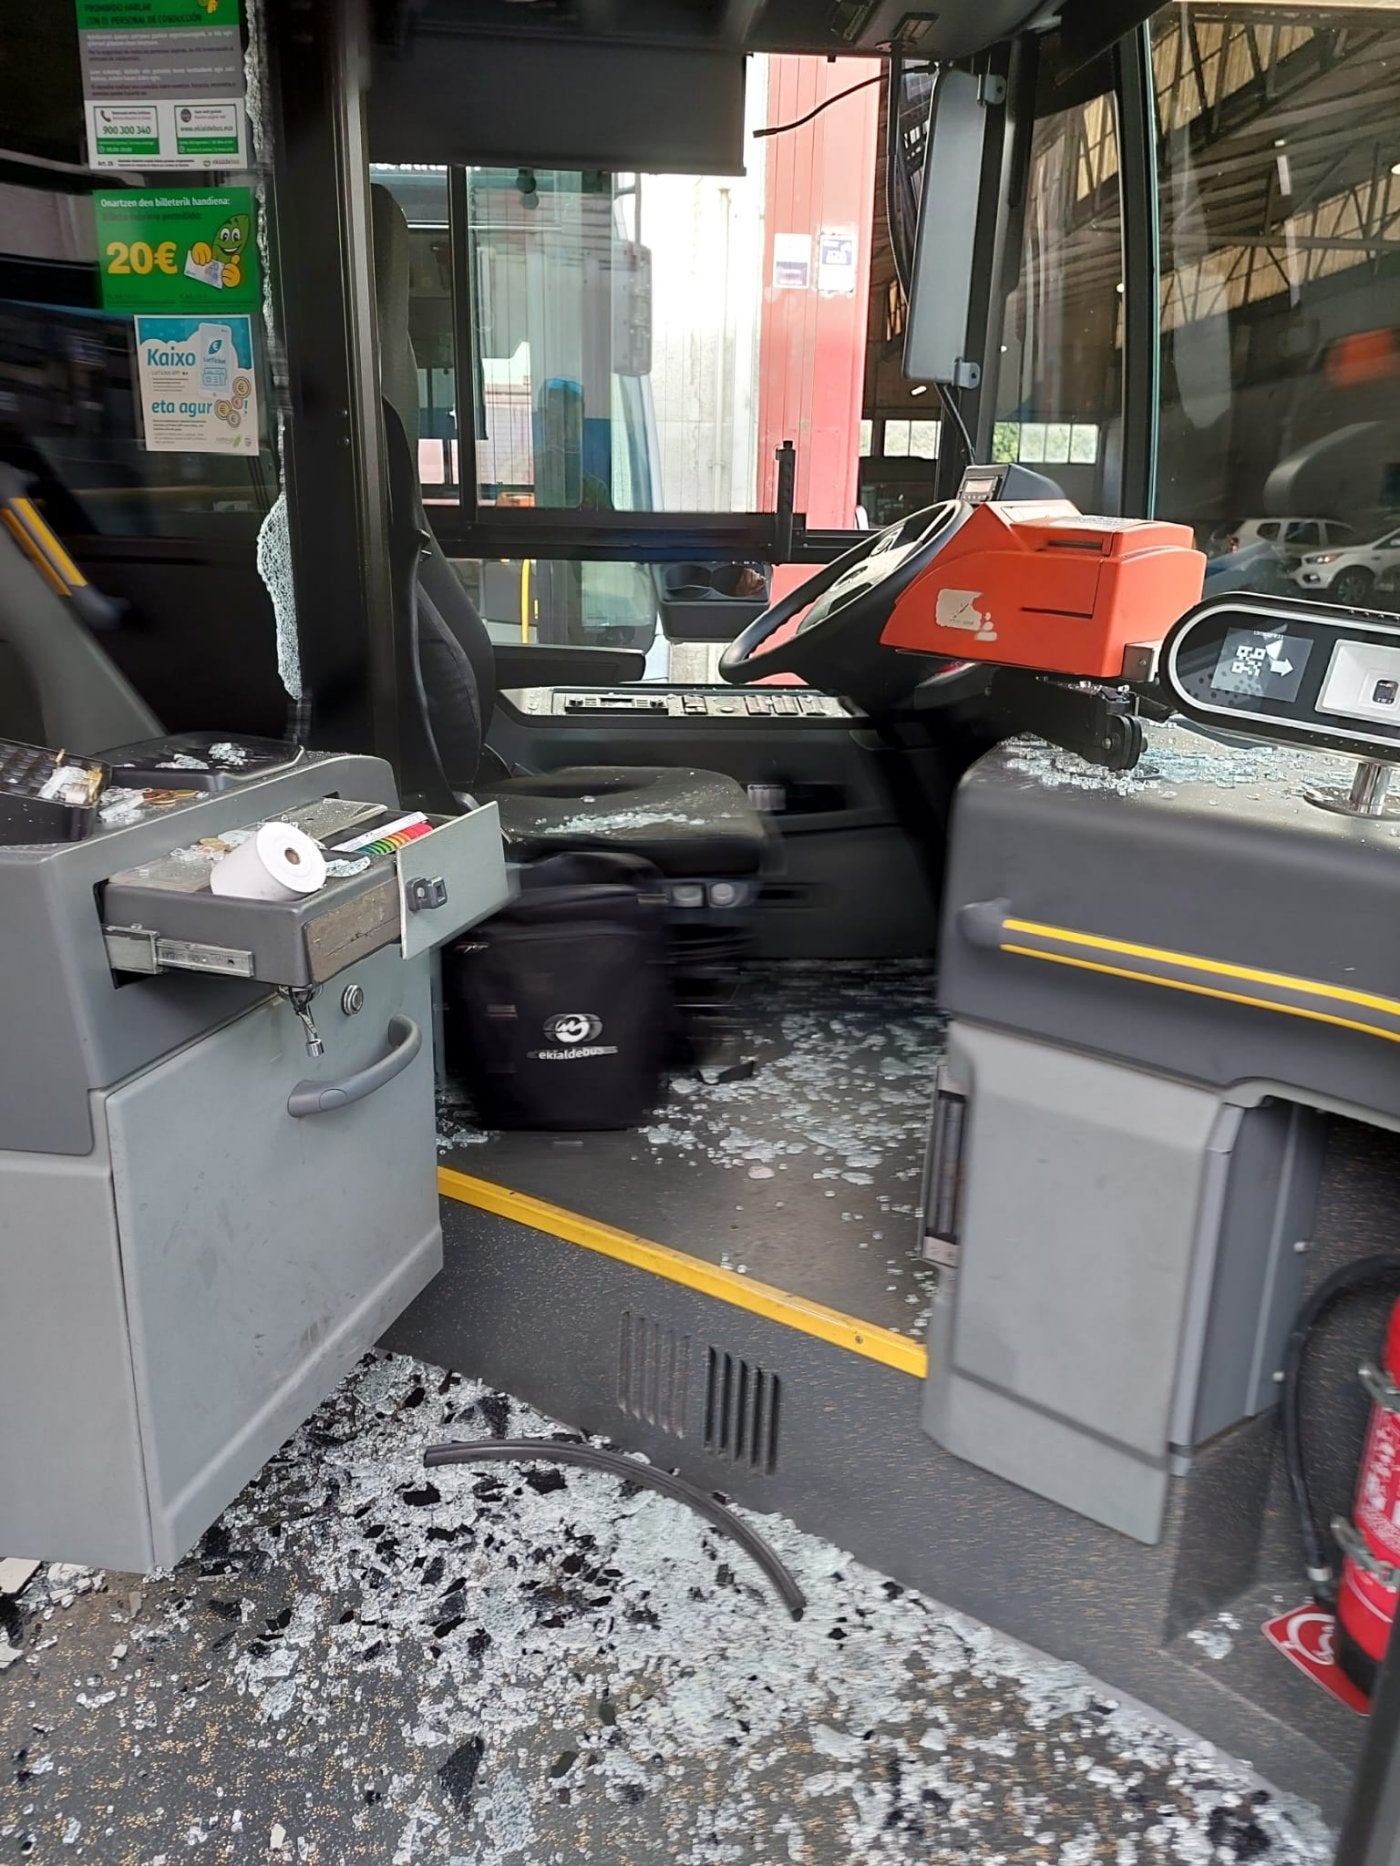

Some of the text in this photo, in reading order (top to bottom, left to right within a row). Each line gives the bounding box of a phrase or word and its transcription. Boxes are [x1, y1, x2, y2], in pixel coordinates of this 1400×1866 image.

[103, 125, 152, 135] 900 300 340
[100, 195, 231, 208] Onartzen den billeterik handiena:
[106, 241, 178, 275] 20€
[147, 346, 196, 367] Kaixo
[151, 401, 175, 414] eta
[179, 401, 213, 418] agur
[538, 1046, 604, 1060] ekialdebus
